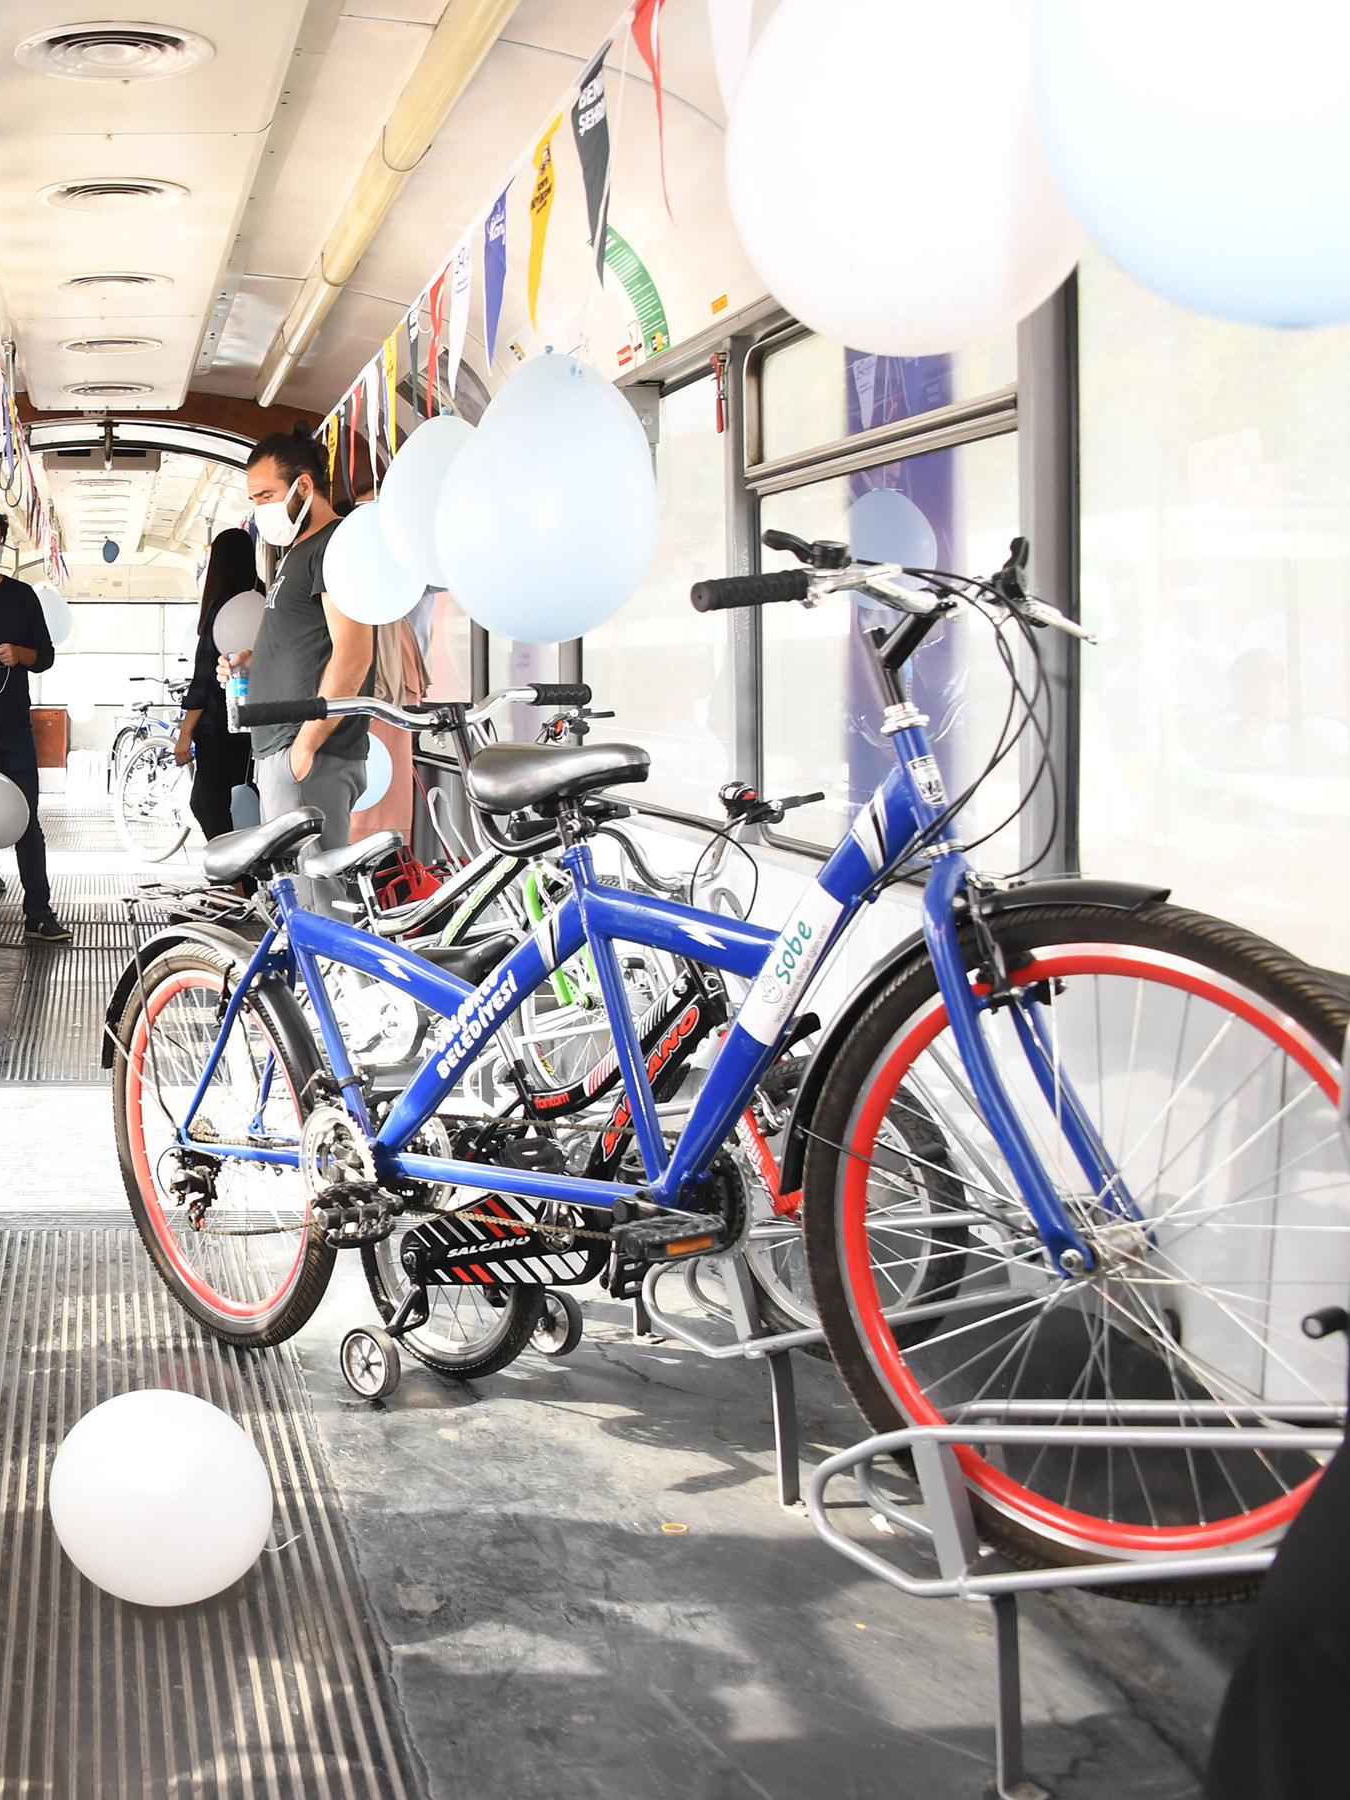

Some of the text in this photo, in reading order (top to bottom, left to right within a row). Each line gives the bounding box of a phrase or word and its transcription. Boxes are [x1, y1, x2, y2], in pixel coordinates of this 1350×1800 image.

[775, 920, 812, 985] sobe
[436, 969, 518, 1079] BELEDİYESİ
[446, 1235, 531, 1258] SALCANO
